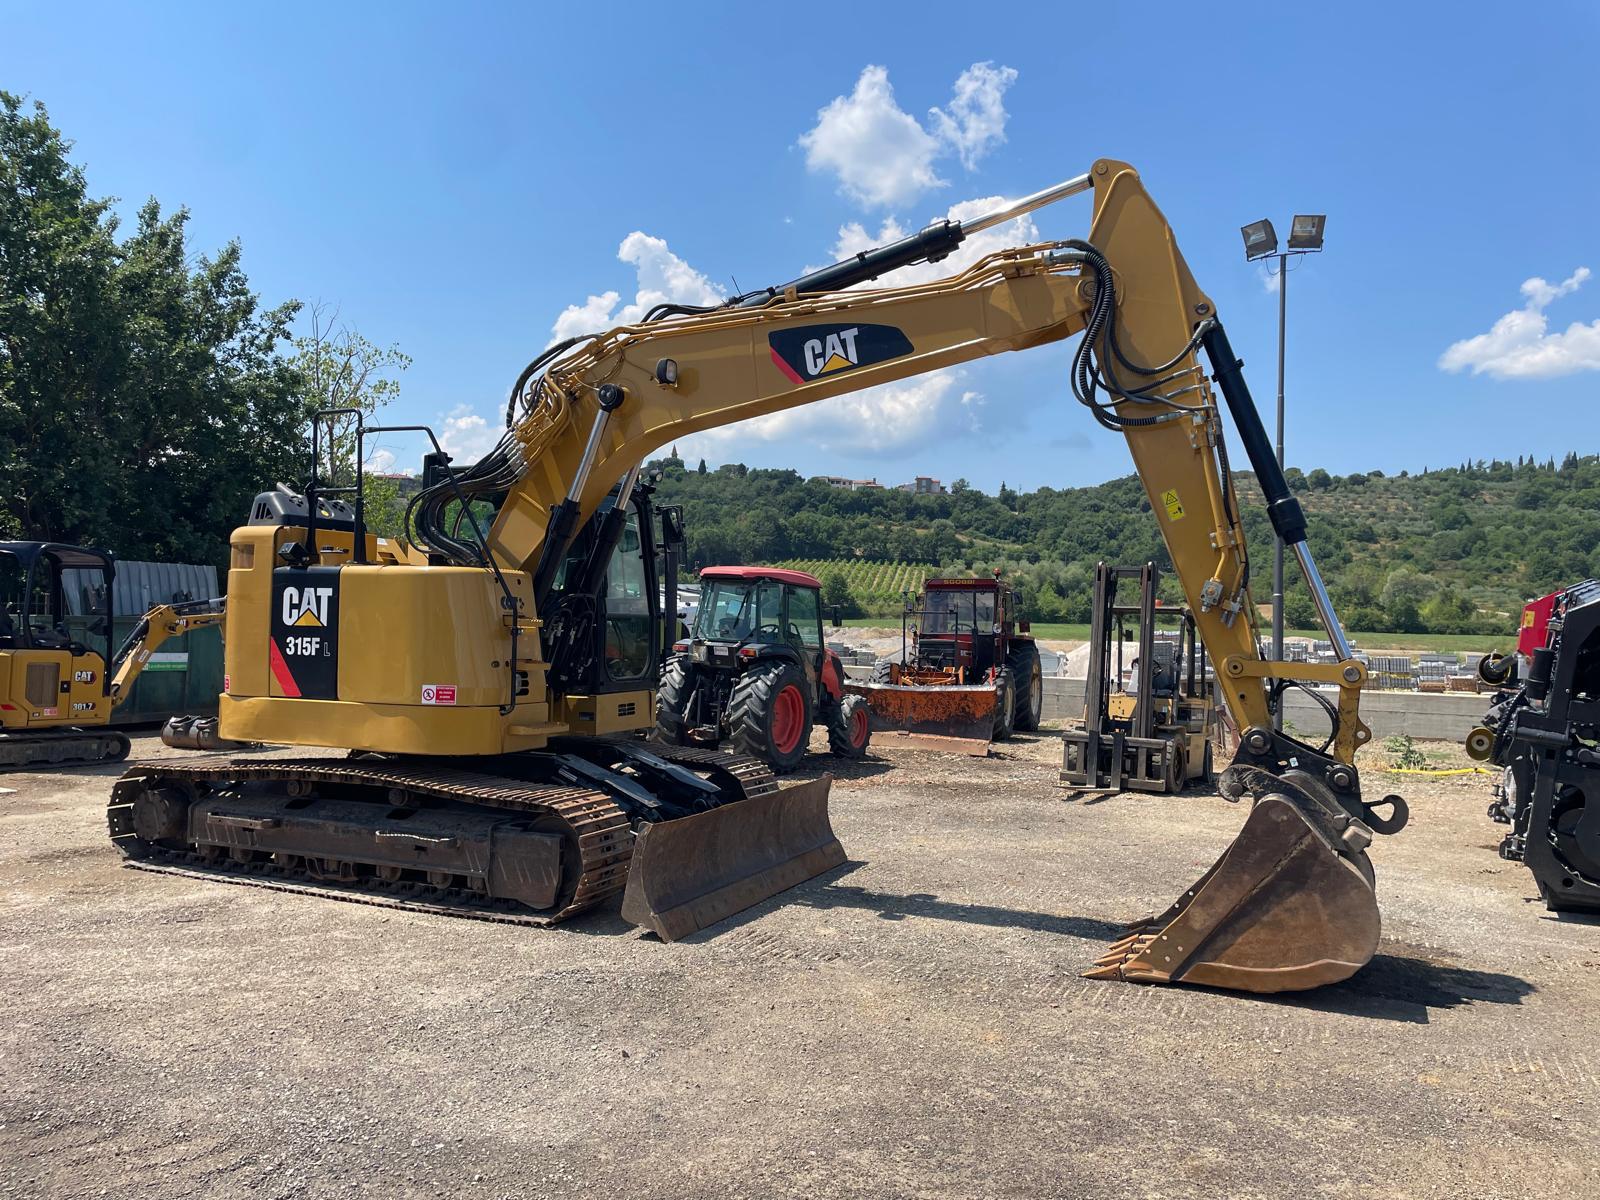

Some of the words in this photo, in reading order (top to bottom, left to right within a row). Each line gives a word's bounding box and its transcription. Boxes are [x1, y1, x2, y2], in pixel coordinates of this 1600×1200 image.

[804, 328, 858, 376] CAT
[282, 586, 333, 627] CAT
[285, 636, 321, 657] 315F
[323, 642, 331, 657] L
[75, 671, 93, 682] CAT
[73, 702, 93, 711] 301.7
